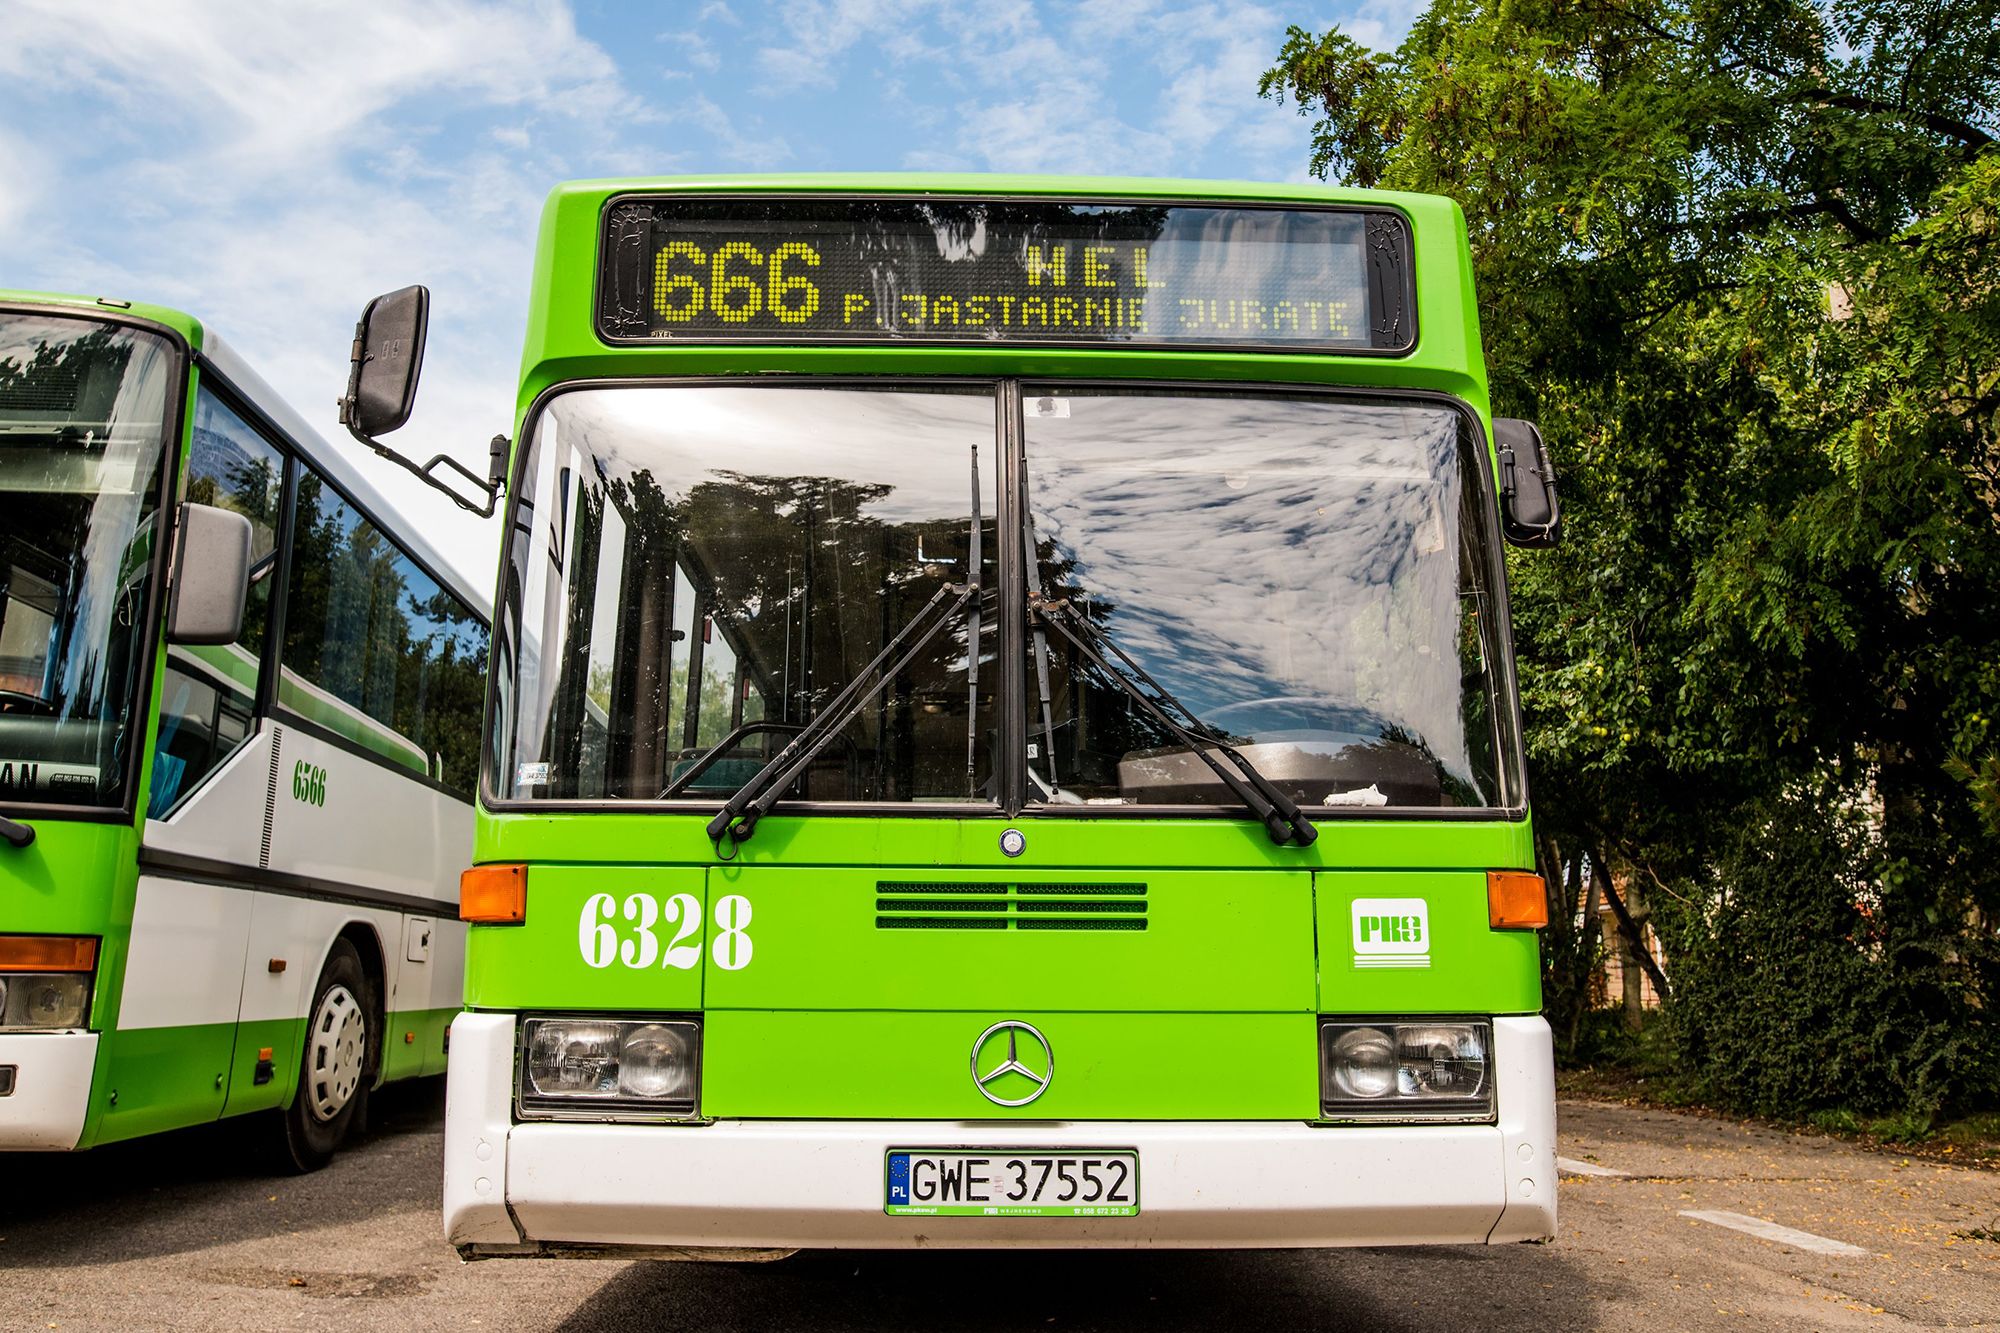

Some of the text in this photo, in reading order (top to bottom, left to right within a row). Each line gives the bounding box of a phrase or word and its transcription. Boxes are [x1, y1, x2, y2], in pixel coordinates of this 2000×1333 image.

[653, 241, 820, 322] 666
[1028, 246, 1166, 287] HEL
[293, 760, 326, 807] 6566
[578, 893, 753, 970] 6328
[1360, 916, 1421, 942] PKS
[892, 1187, 906, 1197] PL
[912, 1159, 1129, 1201] GWE 37552
